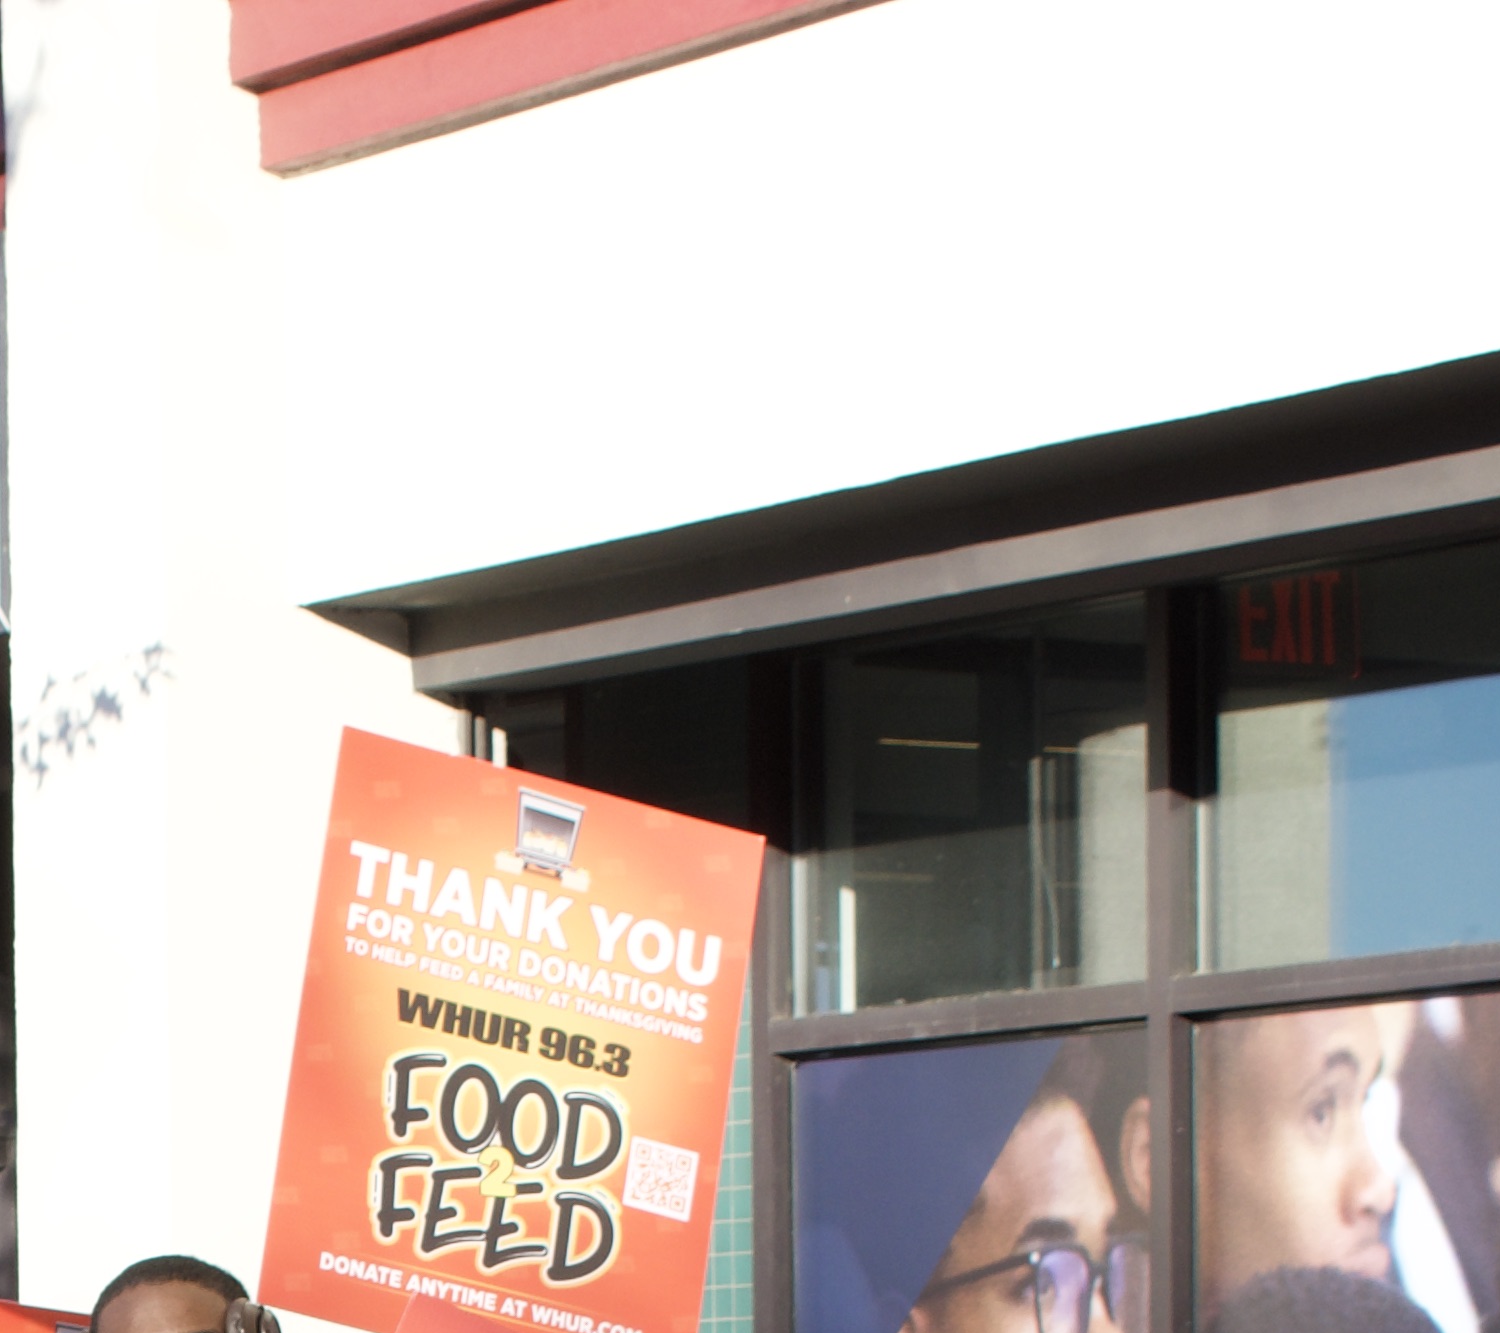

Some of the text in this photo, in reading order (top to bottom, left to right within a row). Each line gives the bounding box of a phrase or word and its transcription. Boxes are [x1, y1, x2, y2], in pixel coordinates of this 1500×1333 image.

[1237, 568, 1342, 666] EXIT
[342, 899, 707, 1024] FOR YOUR DONATIONS
[345, 836, 722, 989] THANK YOU
[394, 985, 633, 1081] WHUR 96.3
[387, 1050, 626, 1185] FOOD
[373, 1150, 616, 1284] FEED
[317, 1249, 404, 1288] DONATE
[404, 1271, 498, 1310] ANYTIME
[499, 1295, 528, 1317] AT
